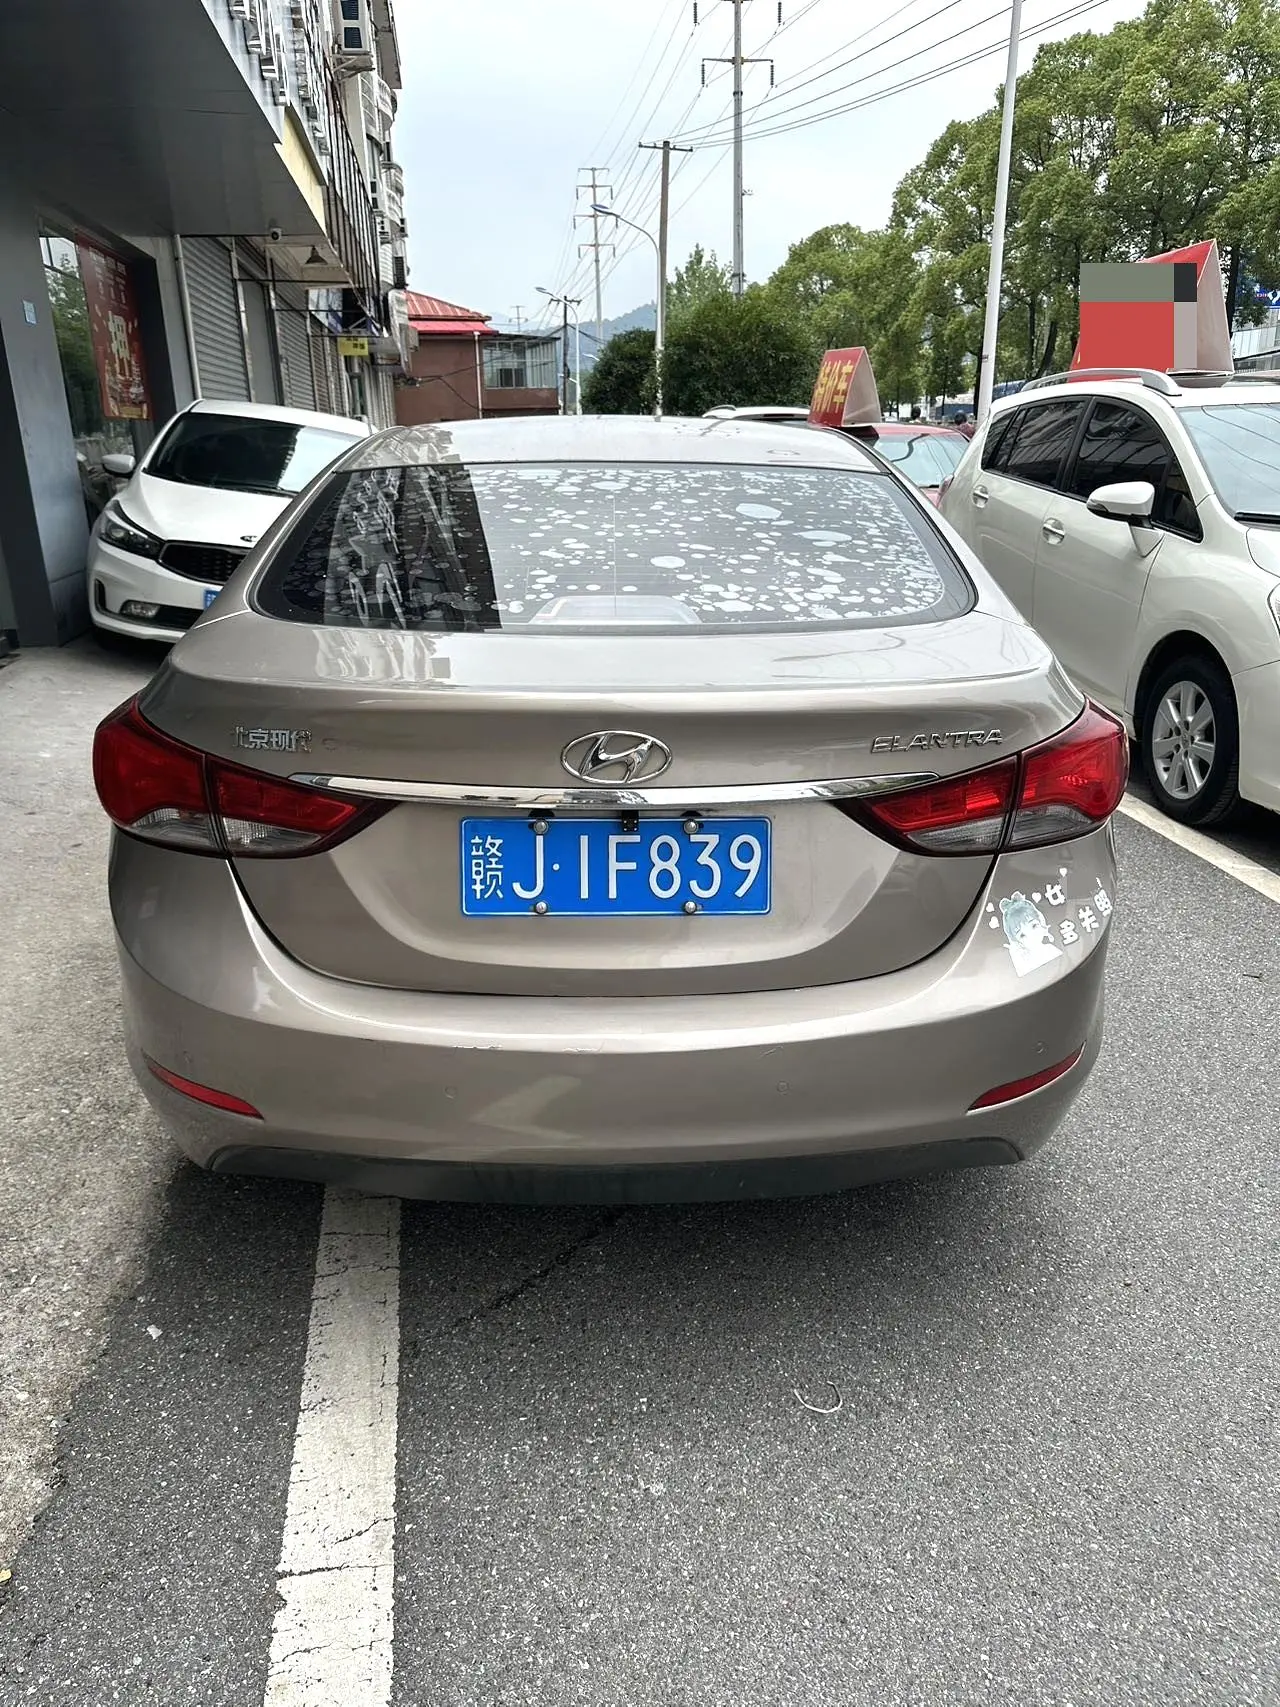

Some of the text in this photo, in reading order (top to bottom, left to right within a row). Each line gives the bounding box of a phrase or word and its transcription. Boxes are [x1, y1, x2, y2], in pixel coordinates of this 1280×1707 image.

[811, 359, 854, 414] 特价车
[233, 726, 312, 753] 北京现代
[870, 728, 1003, 754] ELANTRA
